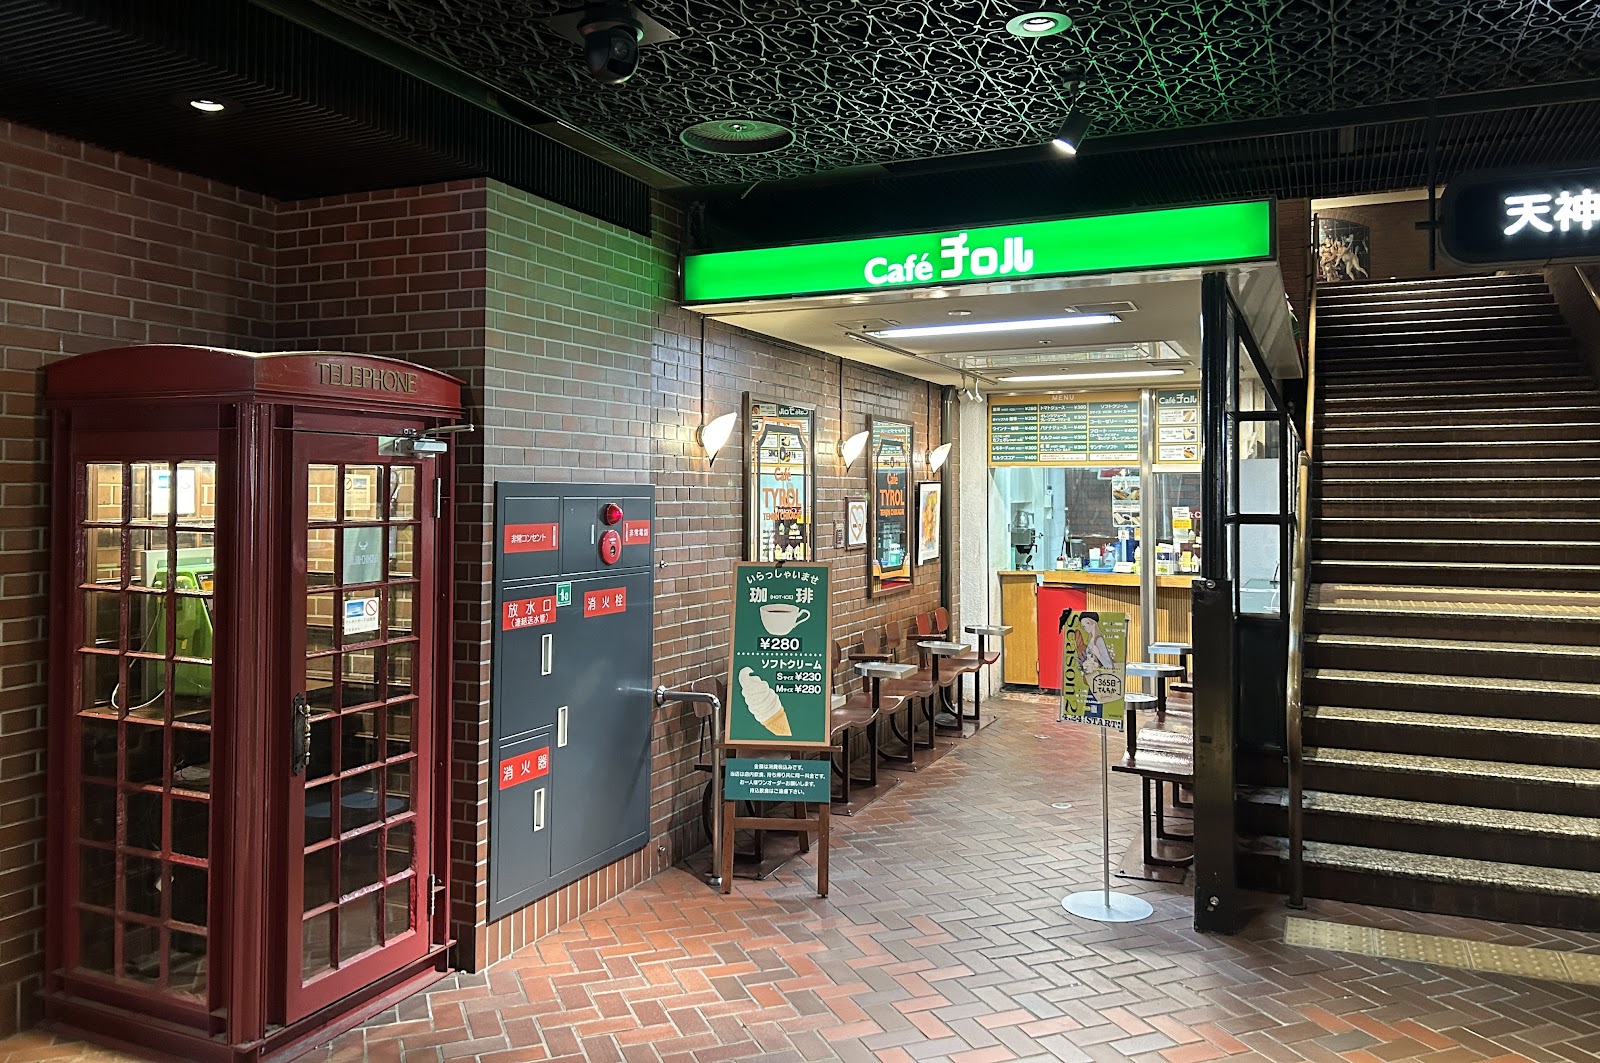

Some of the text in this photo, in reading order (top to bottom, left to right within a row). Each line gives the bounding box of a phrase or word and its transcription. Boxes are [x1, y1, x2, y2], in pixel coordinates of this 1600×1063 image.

[1503, 188, 1600, 236] 天神
[864, 232, 1034, 285] Café チロル
[317, 362, 417, 393] TELEPHONE
[1159, 393, 1198, 404] Café チロル
[774, 467, 791, 482] Café
[887, 472, 899, 486] Café
[762, 488, 801, 508] TYROL
[880, 489, 905, 506] TYROL
[746, 569, 820, 585] いらっしゃいませ
[508, 599, 552, 618] 放水口
[587, 594, 624, 611] 消火栓
[760, 638, 800, 650] ¥280
[1065, 614, 1079, 695] Season
[762, 659, 822, 670] ソフトクリーム
[795, 672, 822, 682] ¥230
[1098, 679, 1116, 687] 365日
[794, 684, 822, 694] ¥280
[1062, 714, 1082, 723] 4.24
[503, 754, 548, 782] 消火器
